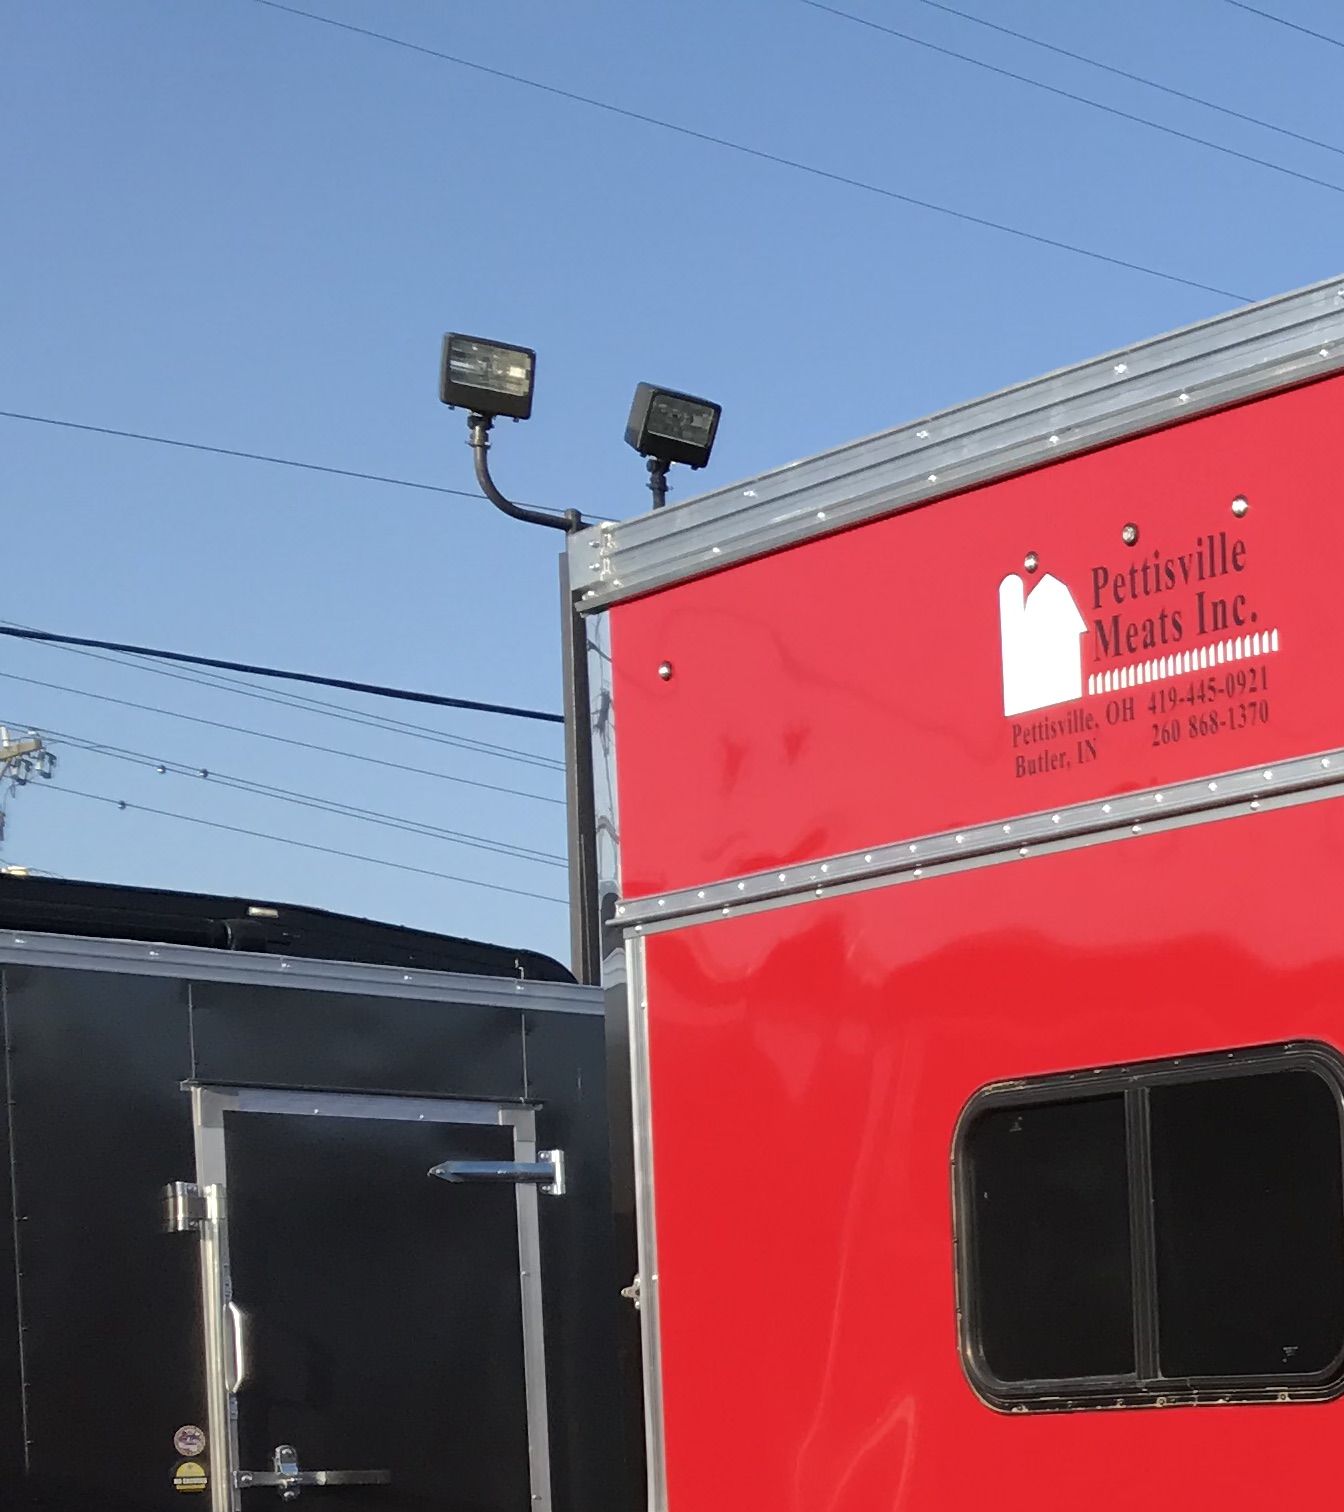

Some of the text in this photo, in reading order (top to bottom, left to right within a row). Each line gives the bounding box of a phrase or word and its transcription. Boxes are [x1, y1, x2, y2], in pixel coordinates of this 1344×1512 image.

[1091, 531, 1246, 609] Pettisville
[1093, 590, 1257, 662] Meats Inc.
[1106, 697, 1135, 725] OH
[1148, 665, 1269, 715] 419-445-0921
[1152, 699, 1269, 747] 260 868-1370
[1015, 738, 1097, 778] Butler, IN
